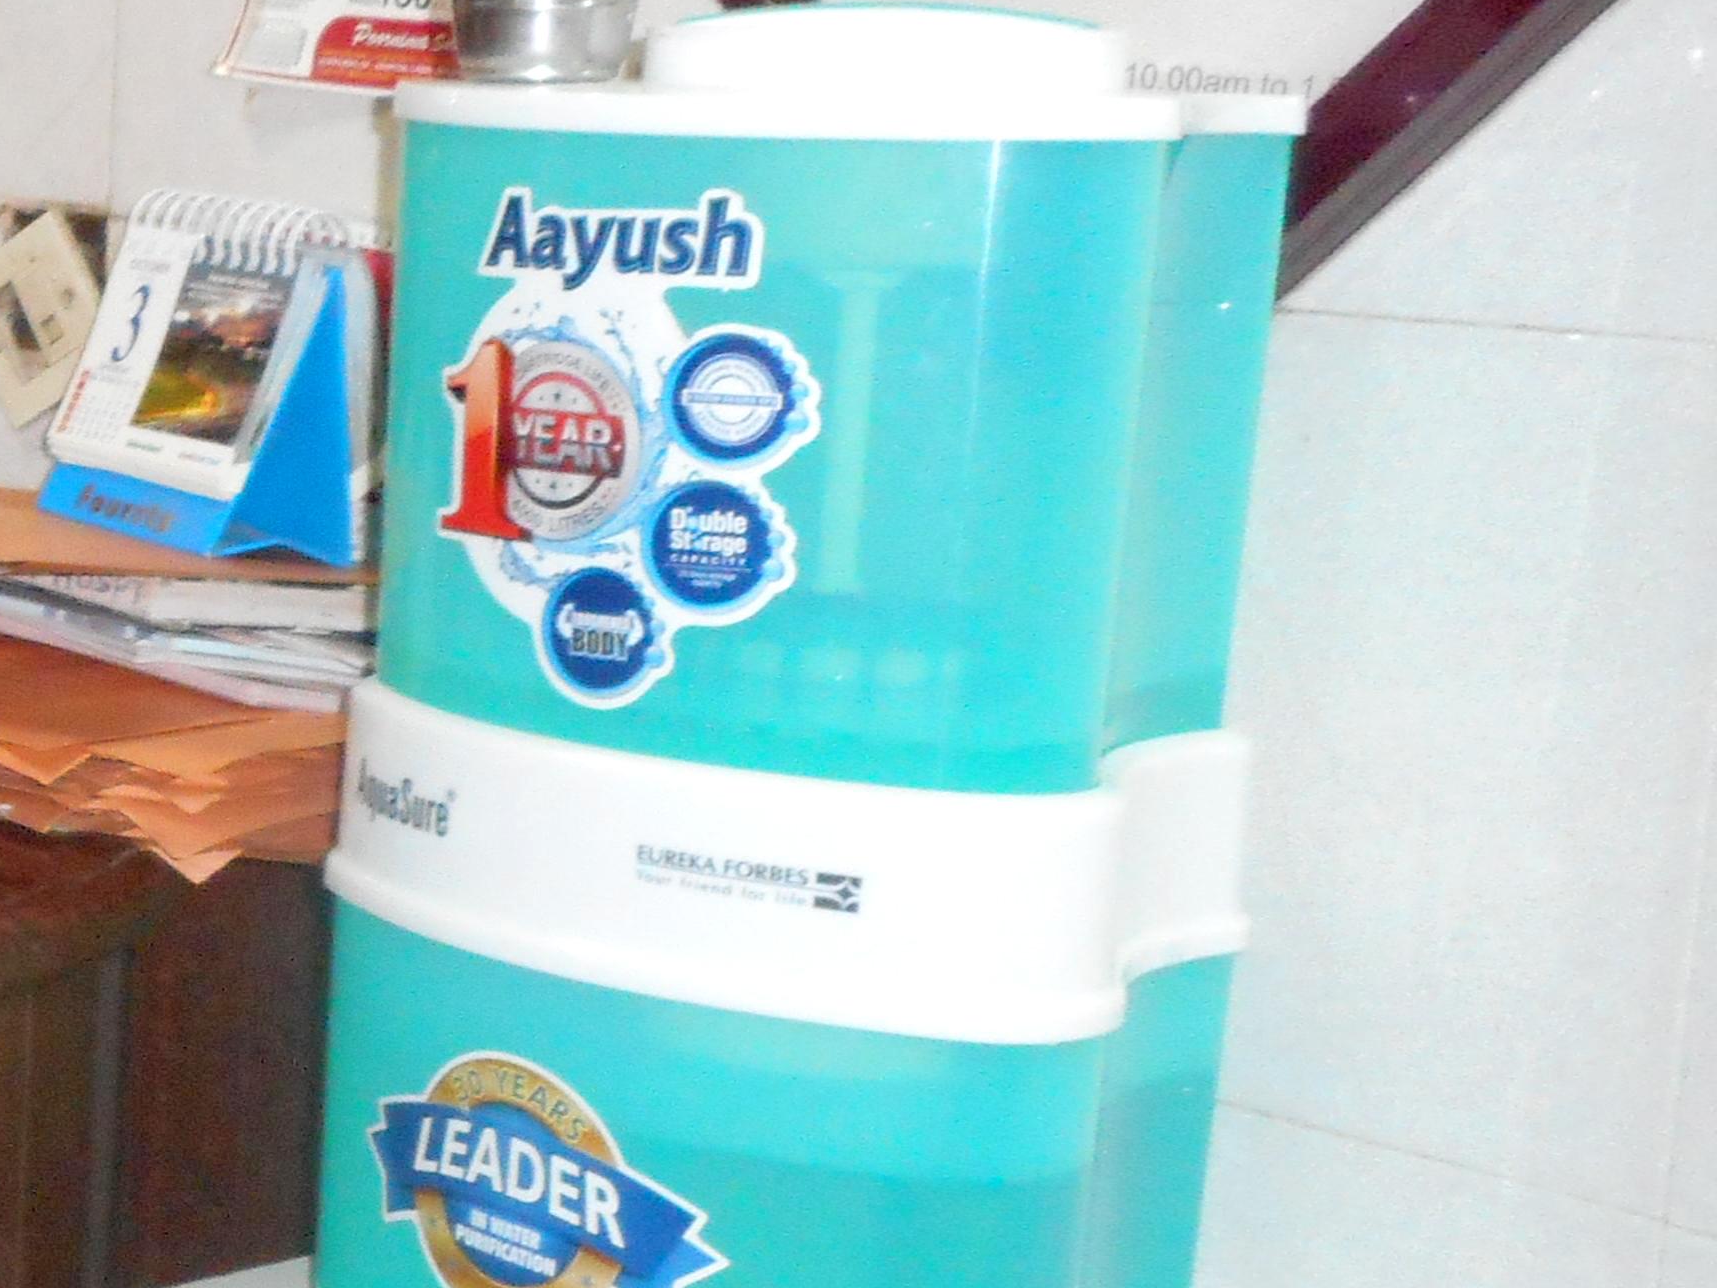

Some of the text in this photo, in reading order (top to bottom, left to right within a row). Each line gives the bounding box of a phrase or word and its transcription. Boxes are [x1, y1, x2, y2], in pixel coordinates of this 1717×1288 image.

[485, 195, 754, 291] Aayush
[111, 283, 152, 363] 3
[441, 338, 616, 541] 1 YEAR
[669, 529, 747, 557] Storage
[670, 505, 748, 535] Double
[571, 626, 629, 660] BODY
[637, 844, 809, 886] EUREKA FORBES
[494, 1067, 587, 1144] YEARS
[412, 1116, 626, 1250] LEADER
[454, 1222, 558, 1278] PURIFICATION
[489, 1216, 542, 1250] WATER
